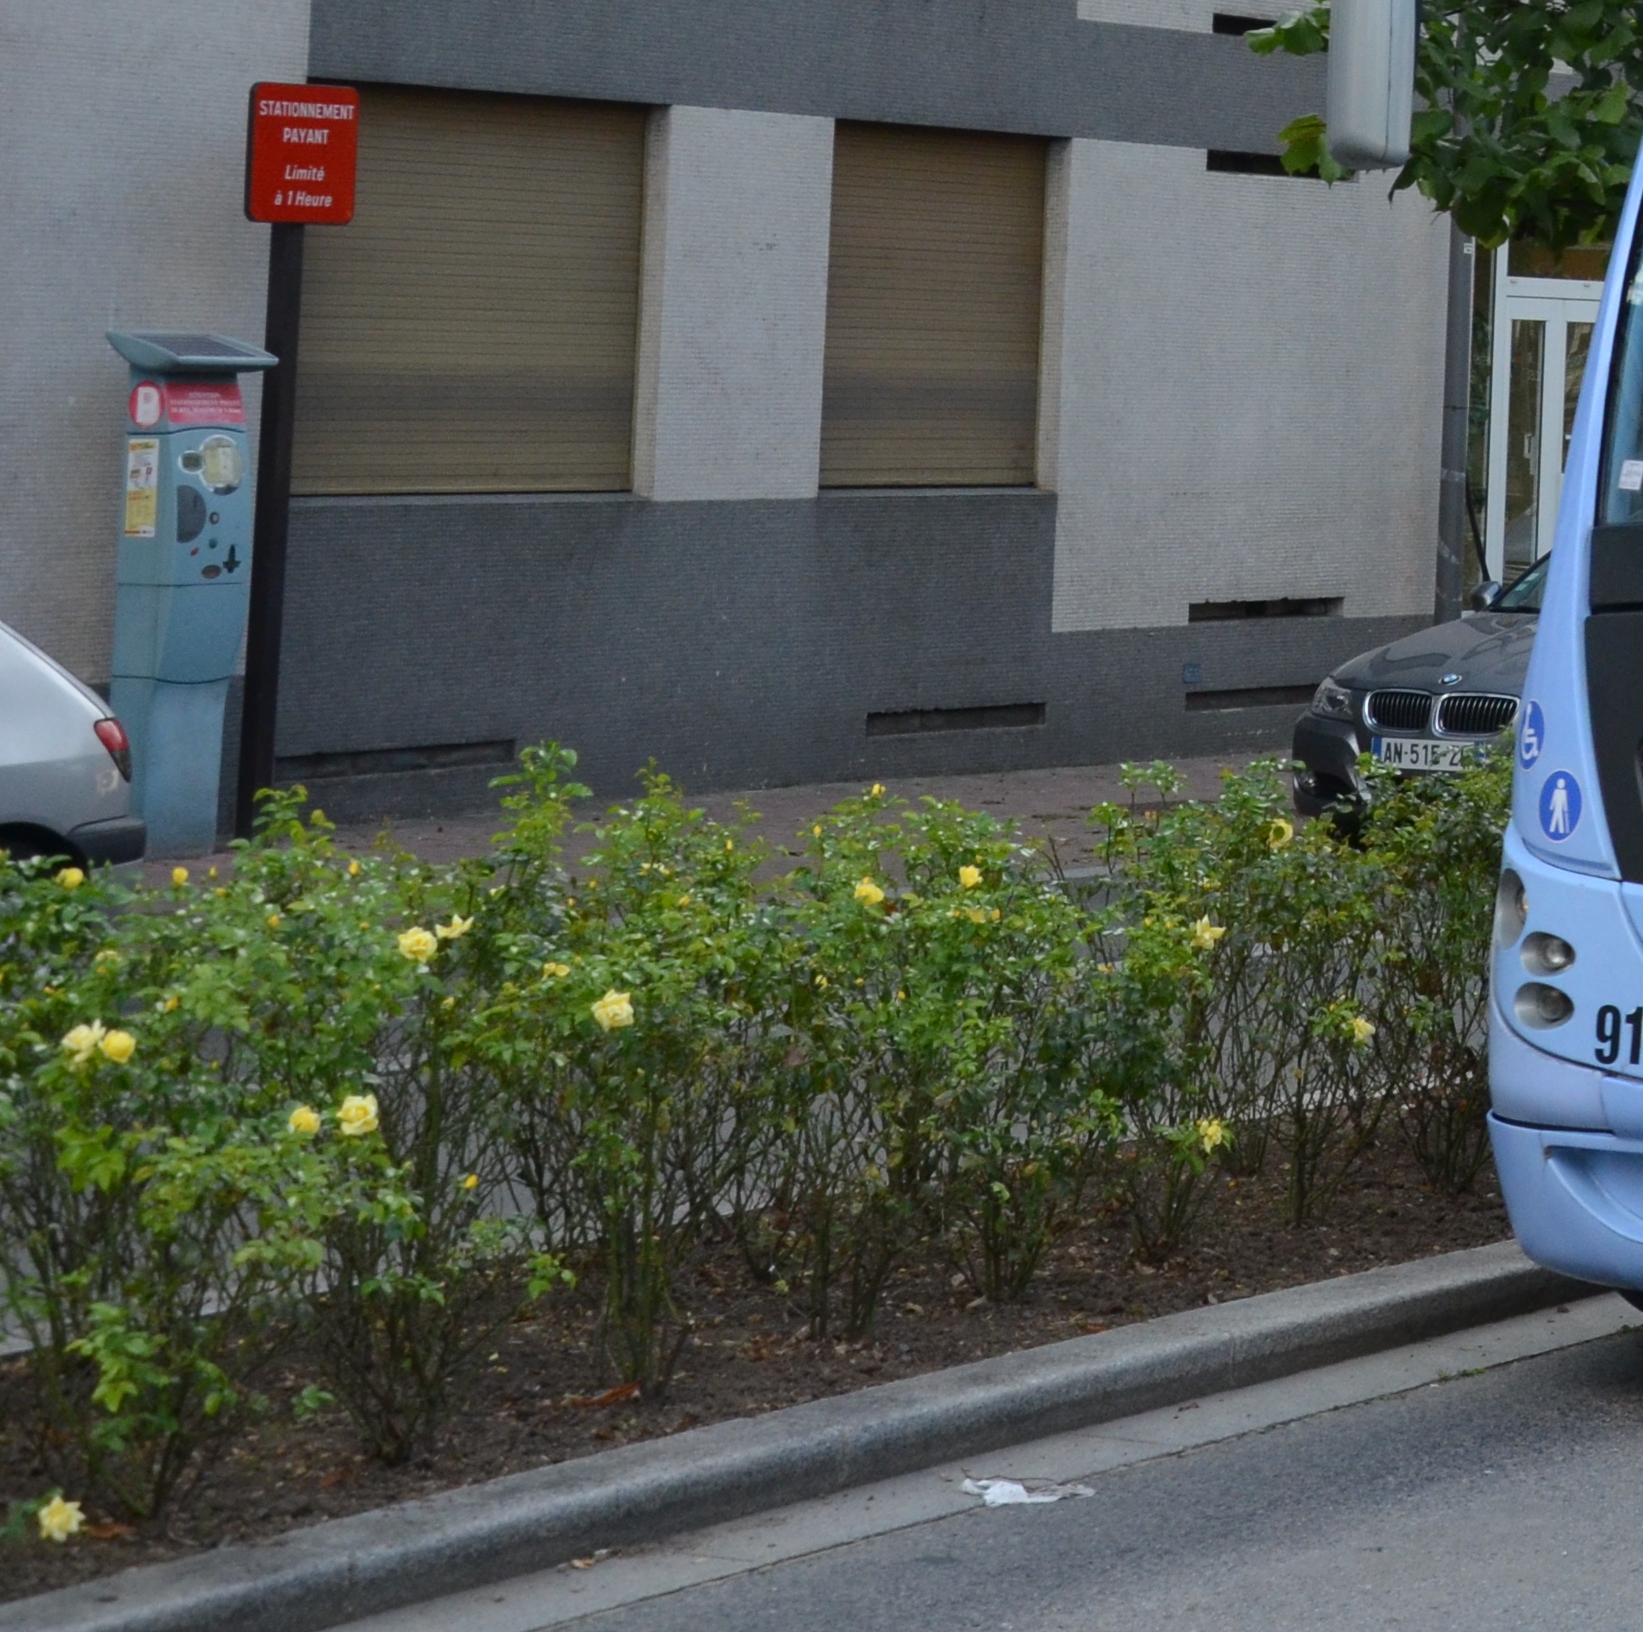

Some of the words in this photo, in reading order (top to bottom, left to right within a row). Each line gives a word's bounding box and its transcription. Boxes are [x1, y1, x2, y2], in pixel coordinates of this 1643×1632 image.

[259, 100, 355, 120] STATIONNEMENT
[282, 127, 330, 145] PAYANT
[284, 164, 325, 182] Limité
[286, 190, 294, 206] 1
[295, 191, 333, 208] Heure
